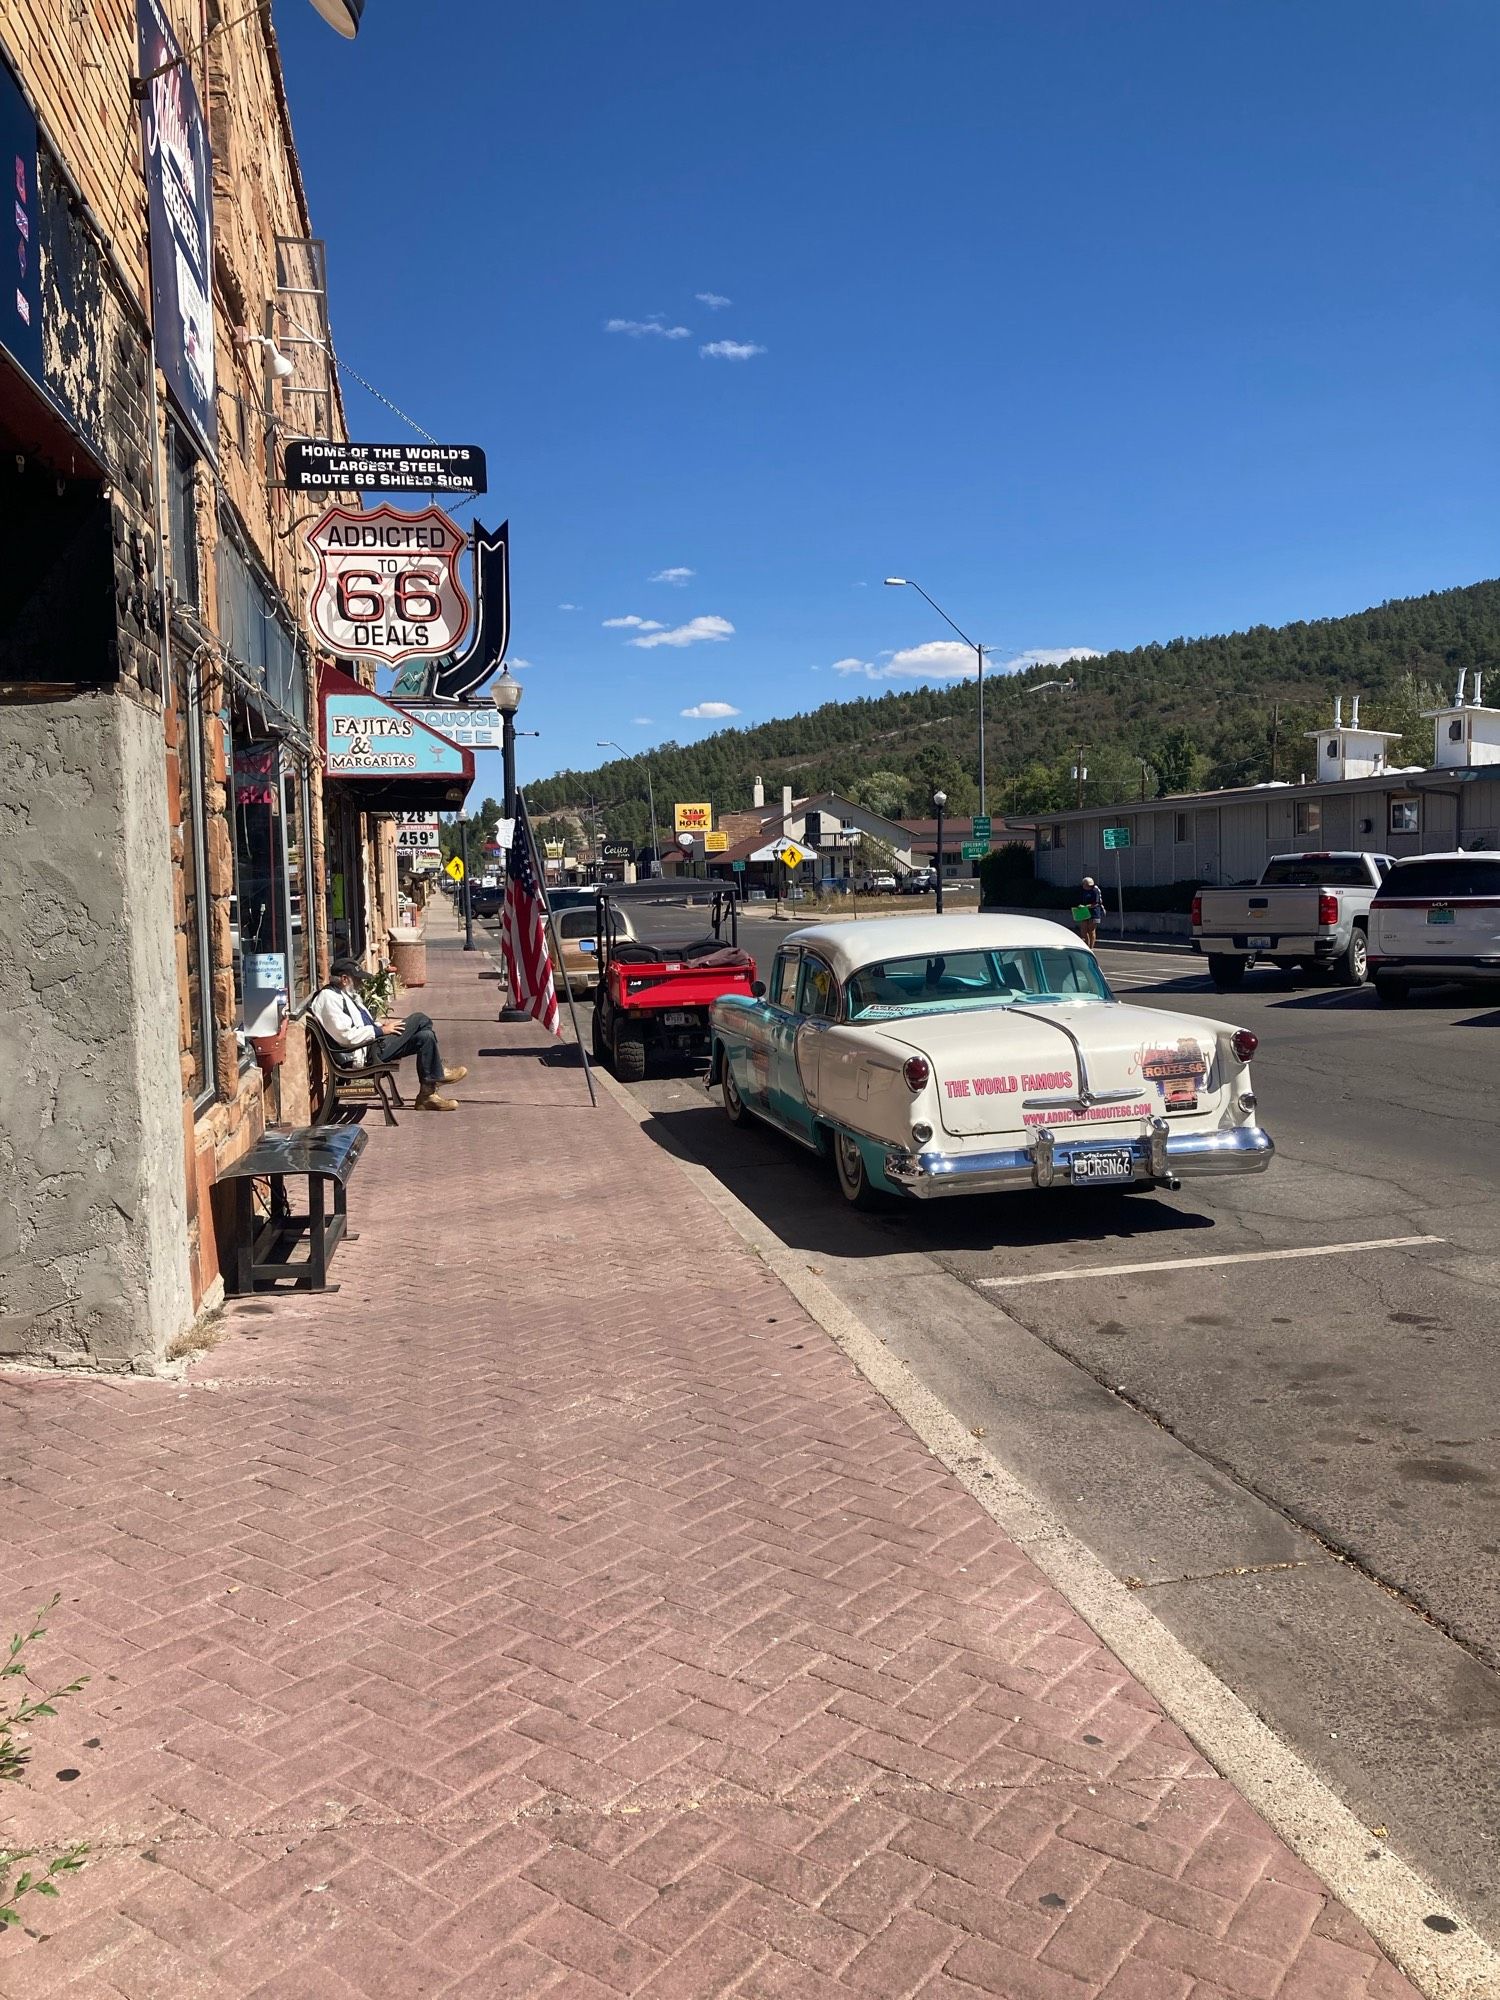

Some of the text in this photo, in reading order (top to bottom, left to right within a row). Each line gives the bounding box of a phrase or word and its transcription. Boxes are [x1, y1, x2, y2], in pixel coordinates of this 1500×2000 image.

[301, 445, 470, 460] HOME OF THE WORLD'S
[329, 459, 445, 473] LARGEST STEEL
[300, 472, 473, 487] ROUTE 66 SHIELD SIGN
[327, 526, 446, 548] ADDICTED
[377, 559, 398, 574] TO
[336, 569, 442, 623] 66
[354, 625, 429, 646] DEALS
[334, 718, 412, 736] FAJITAS
[350, 737, 370, 755] &
[331, 755, 415, 769] MARGARITAS
[945, 1070, 1074, 1098] THE WORLD FAMOUS
[1023, 1103, 1152, 1126] WWW.ADDICTEDTOROUTE66.COM
[1087, 1158, 1131, 1176] CRSN66
